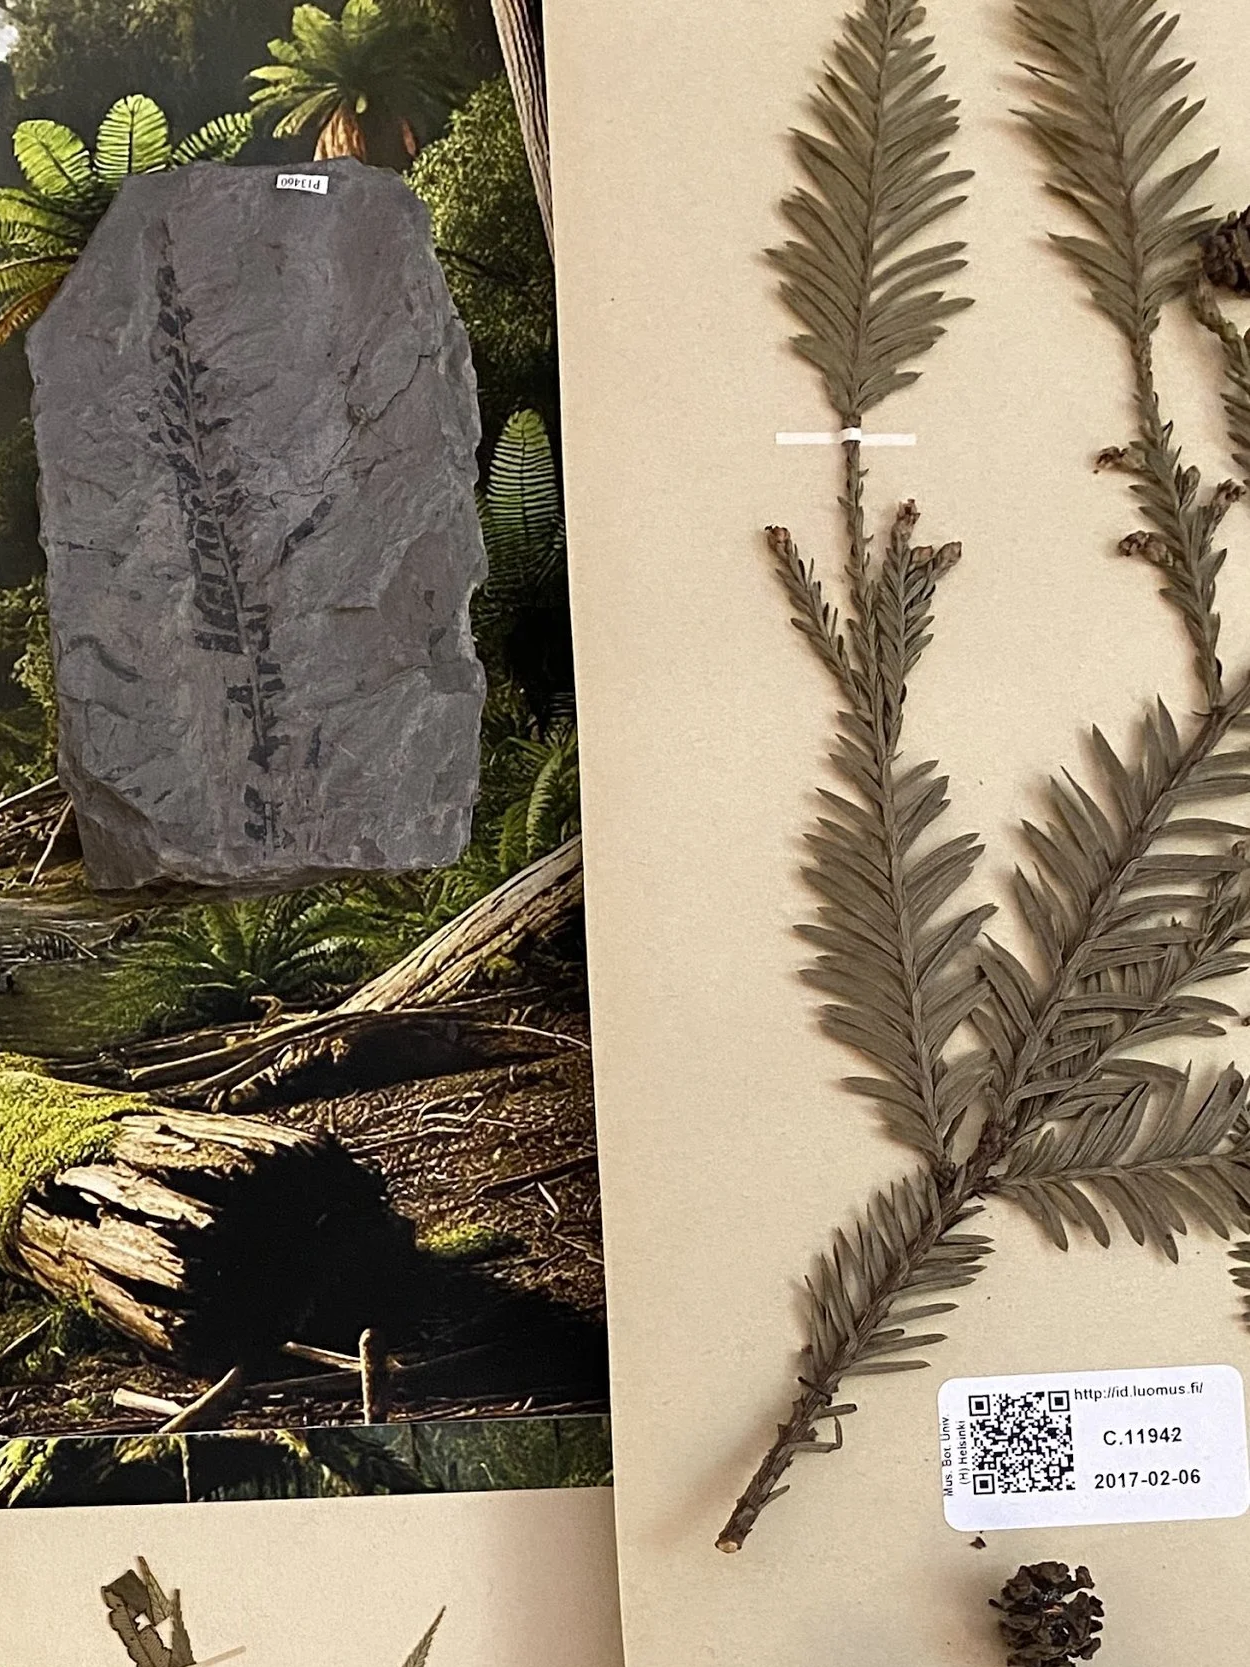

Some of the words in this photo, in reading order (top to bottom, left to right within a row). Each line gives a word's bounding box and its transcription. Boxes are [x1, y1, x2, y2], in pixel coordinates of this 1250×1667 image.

[956, 1420, 969, 1465] Helsinki
[1103, 1426, 1182, 1446] C.11942
[1094, 1468, 1201, 1490] 2017-02-06
